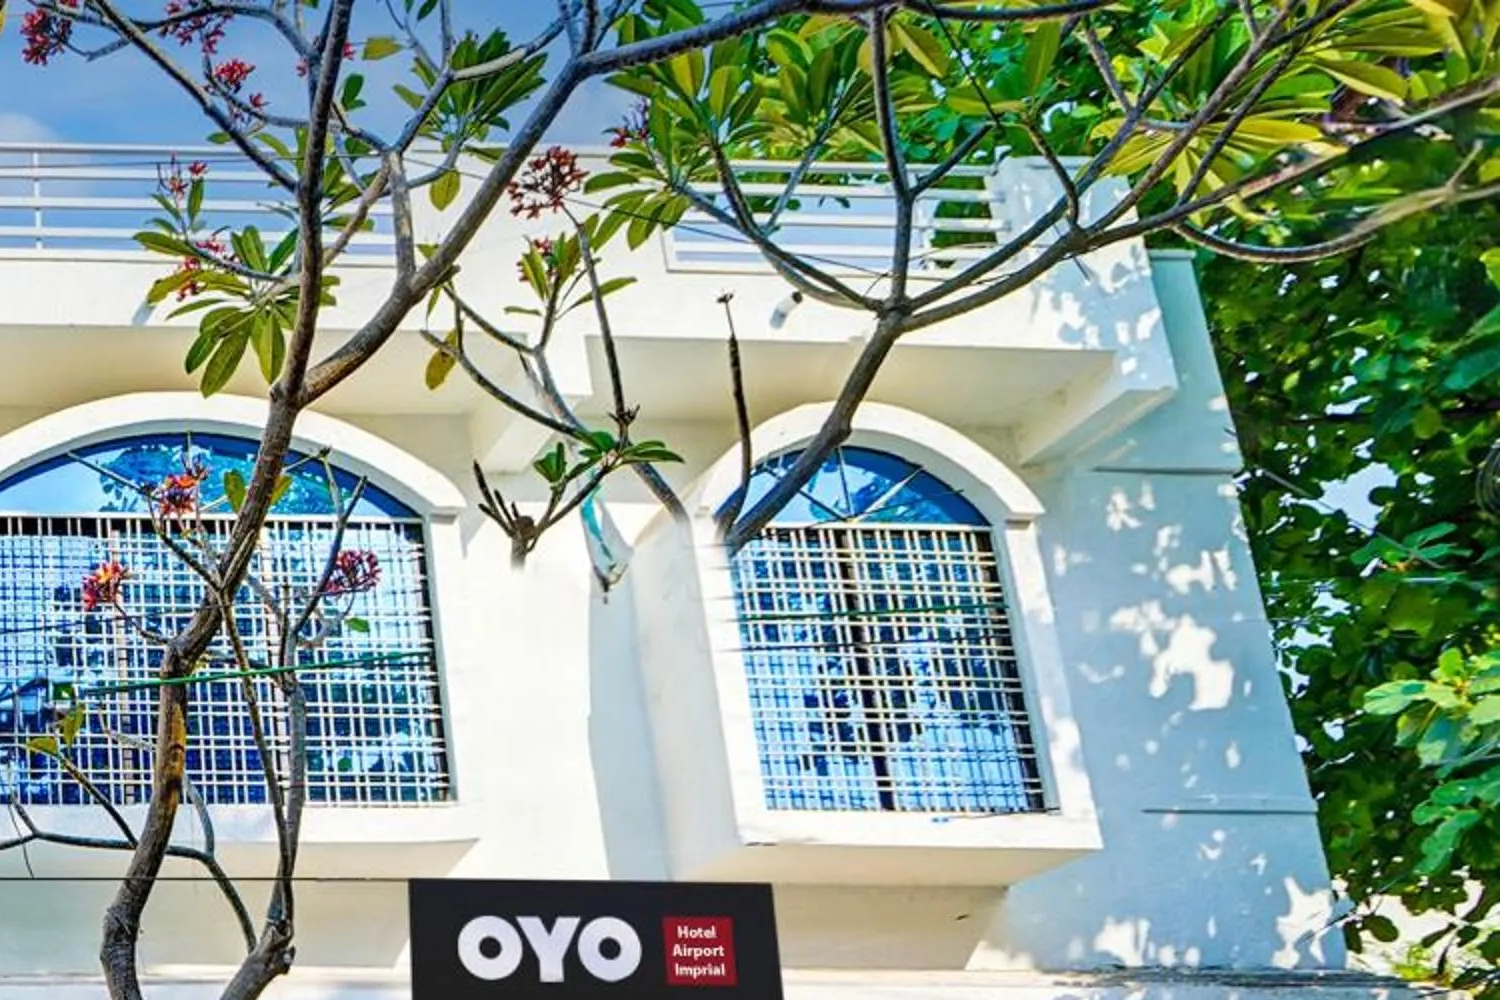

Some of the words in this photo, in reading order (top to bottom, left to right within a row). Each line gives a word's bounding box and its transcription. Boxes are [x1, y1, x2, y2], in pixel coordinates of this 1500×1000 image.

[677, 925, 717, 939] Hotel
[457, 915, 642, 983] OYO
[673, 943, 725, 960] Airport
[675, 962, 726, 980] Imprial
